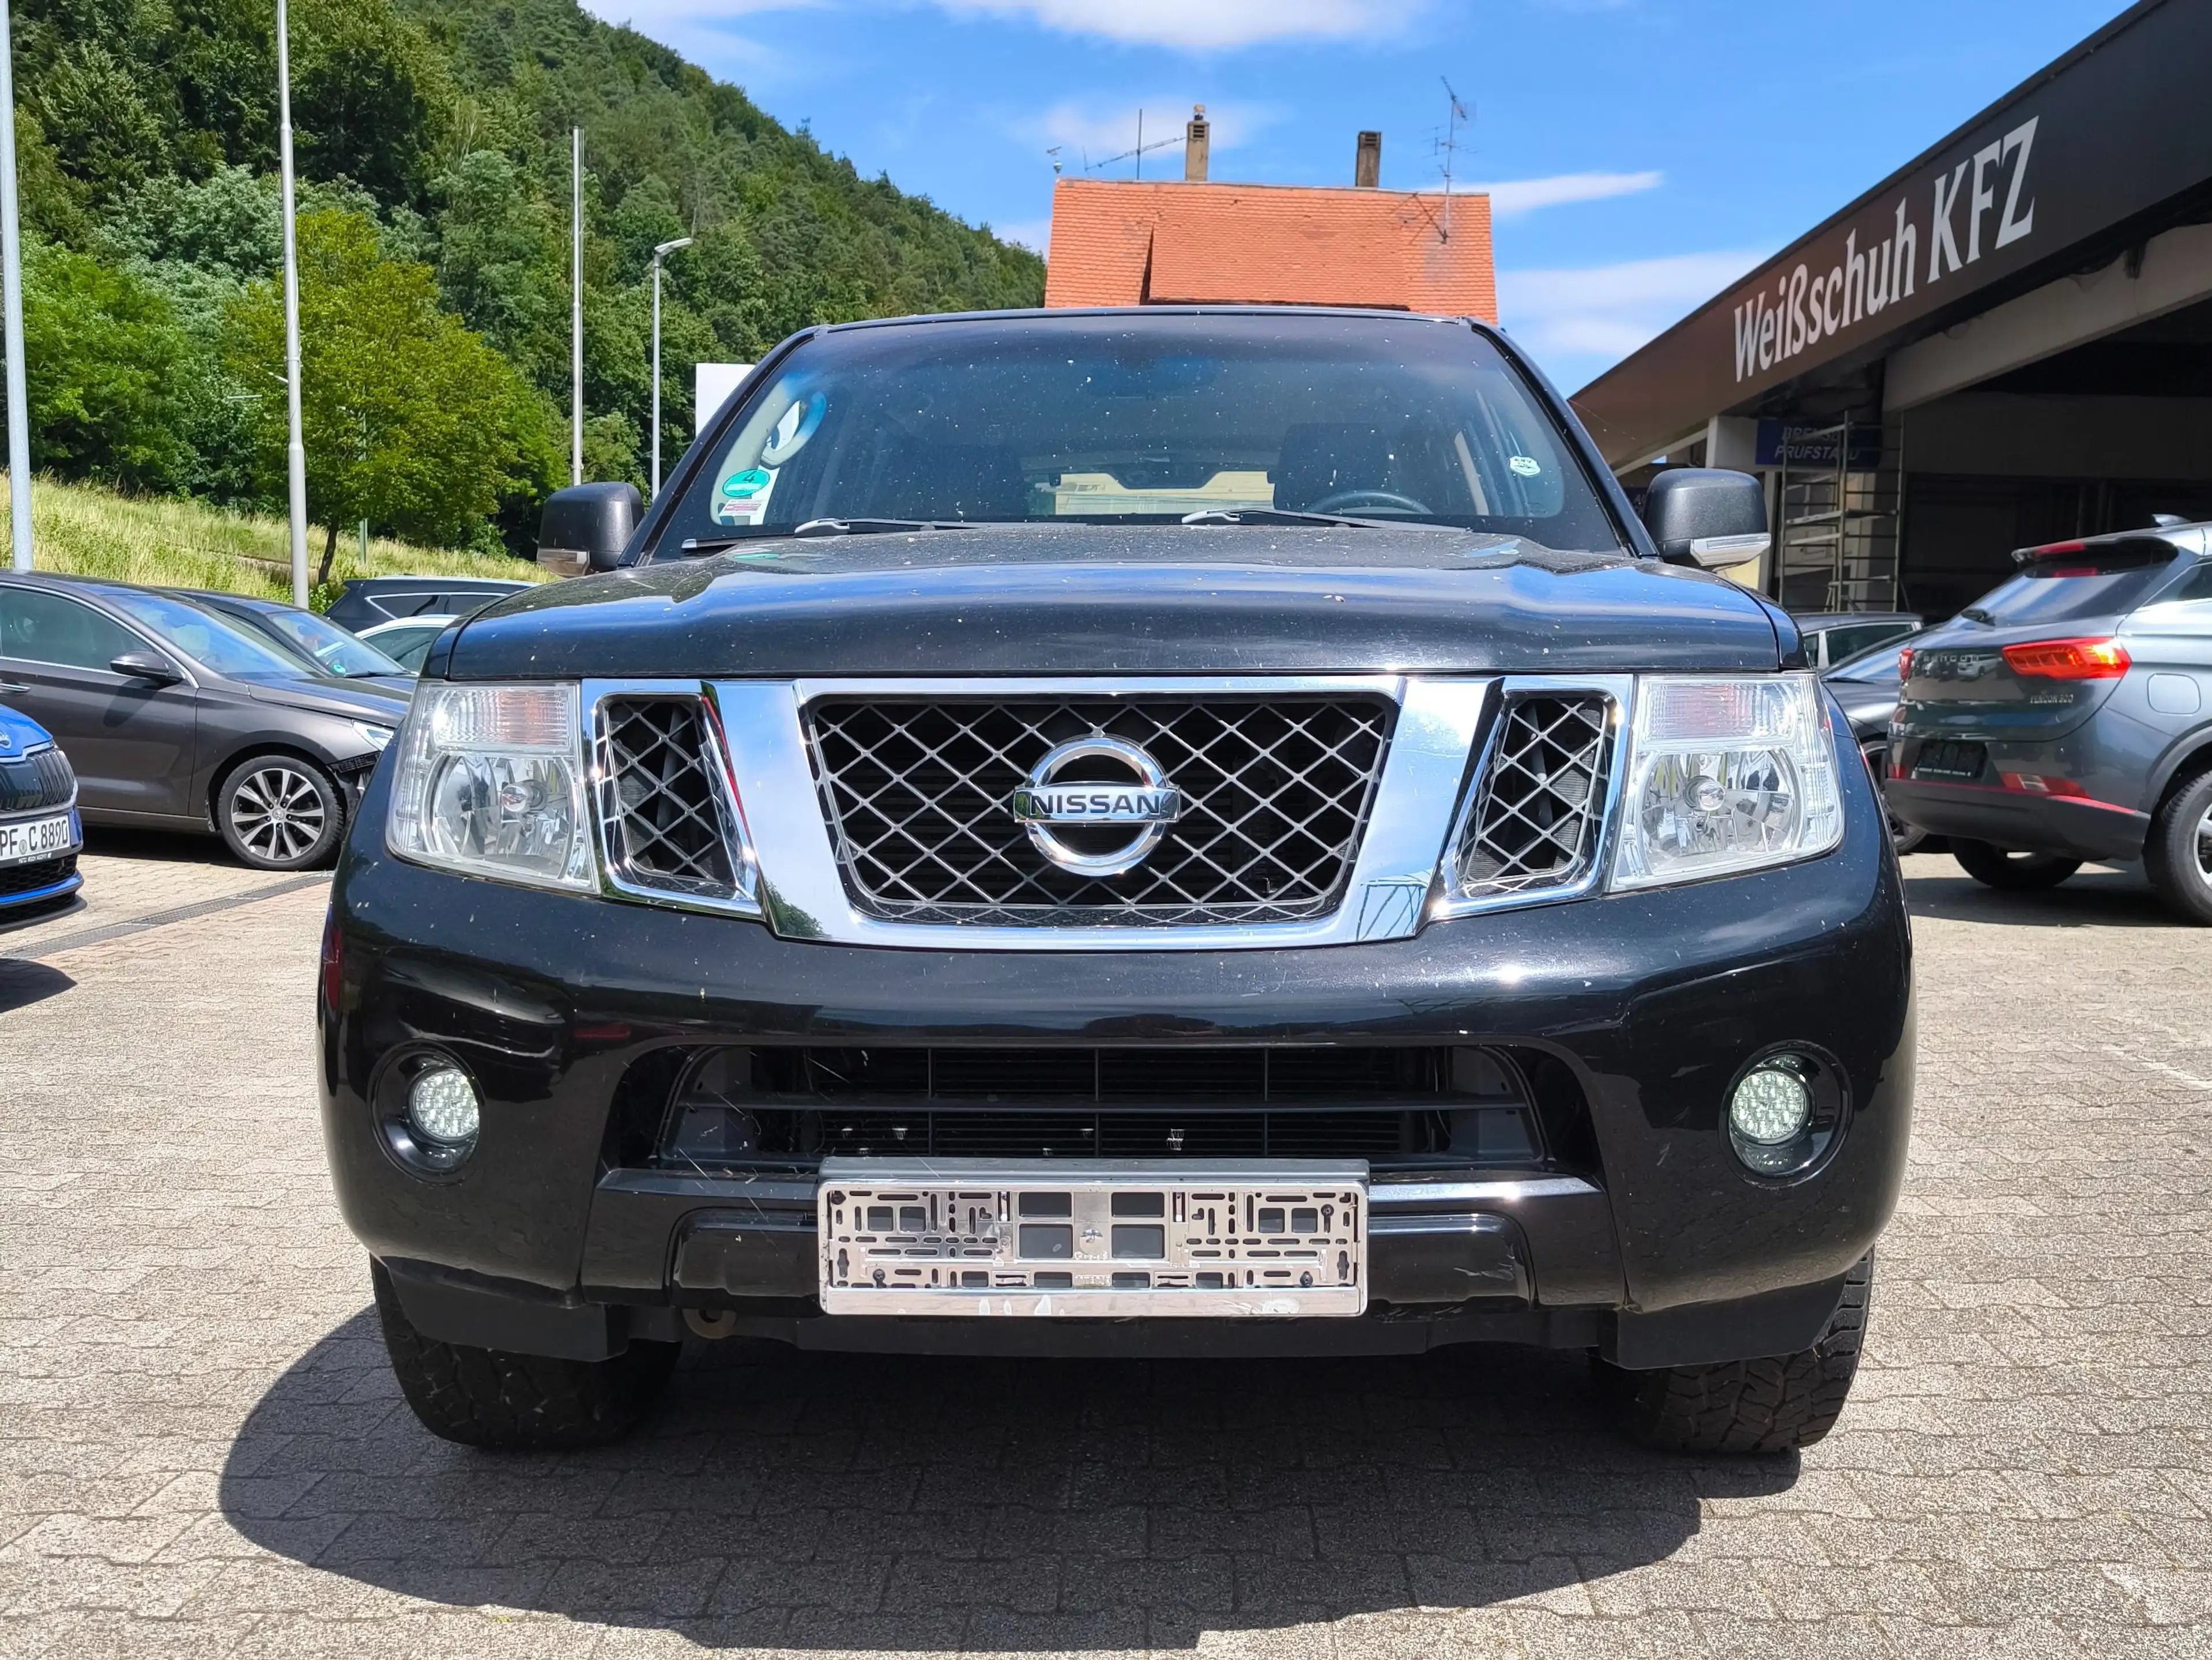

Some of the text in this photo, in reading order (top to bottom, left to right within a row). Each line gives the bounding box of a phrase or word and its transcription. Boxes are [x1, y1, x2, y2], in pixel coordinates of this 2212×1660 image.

[1734, 116, 2040, 383] Weißschuh KFZ
[742, 470, 757, 483] 4
[1030, 794, 1160, 814] NISSAN
[0, 819, 68, 856] PF C 8890
